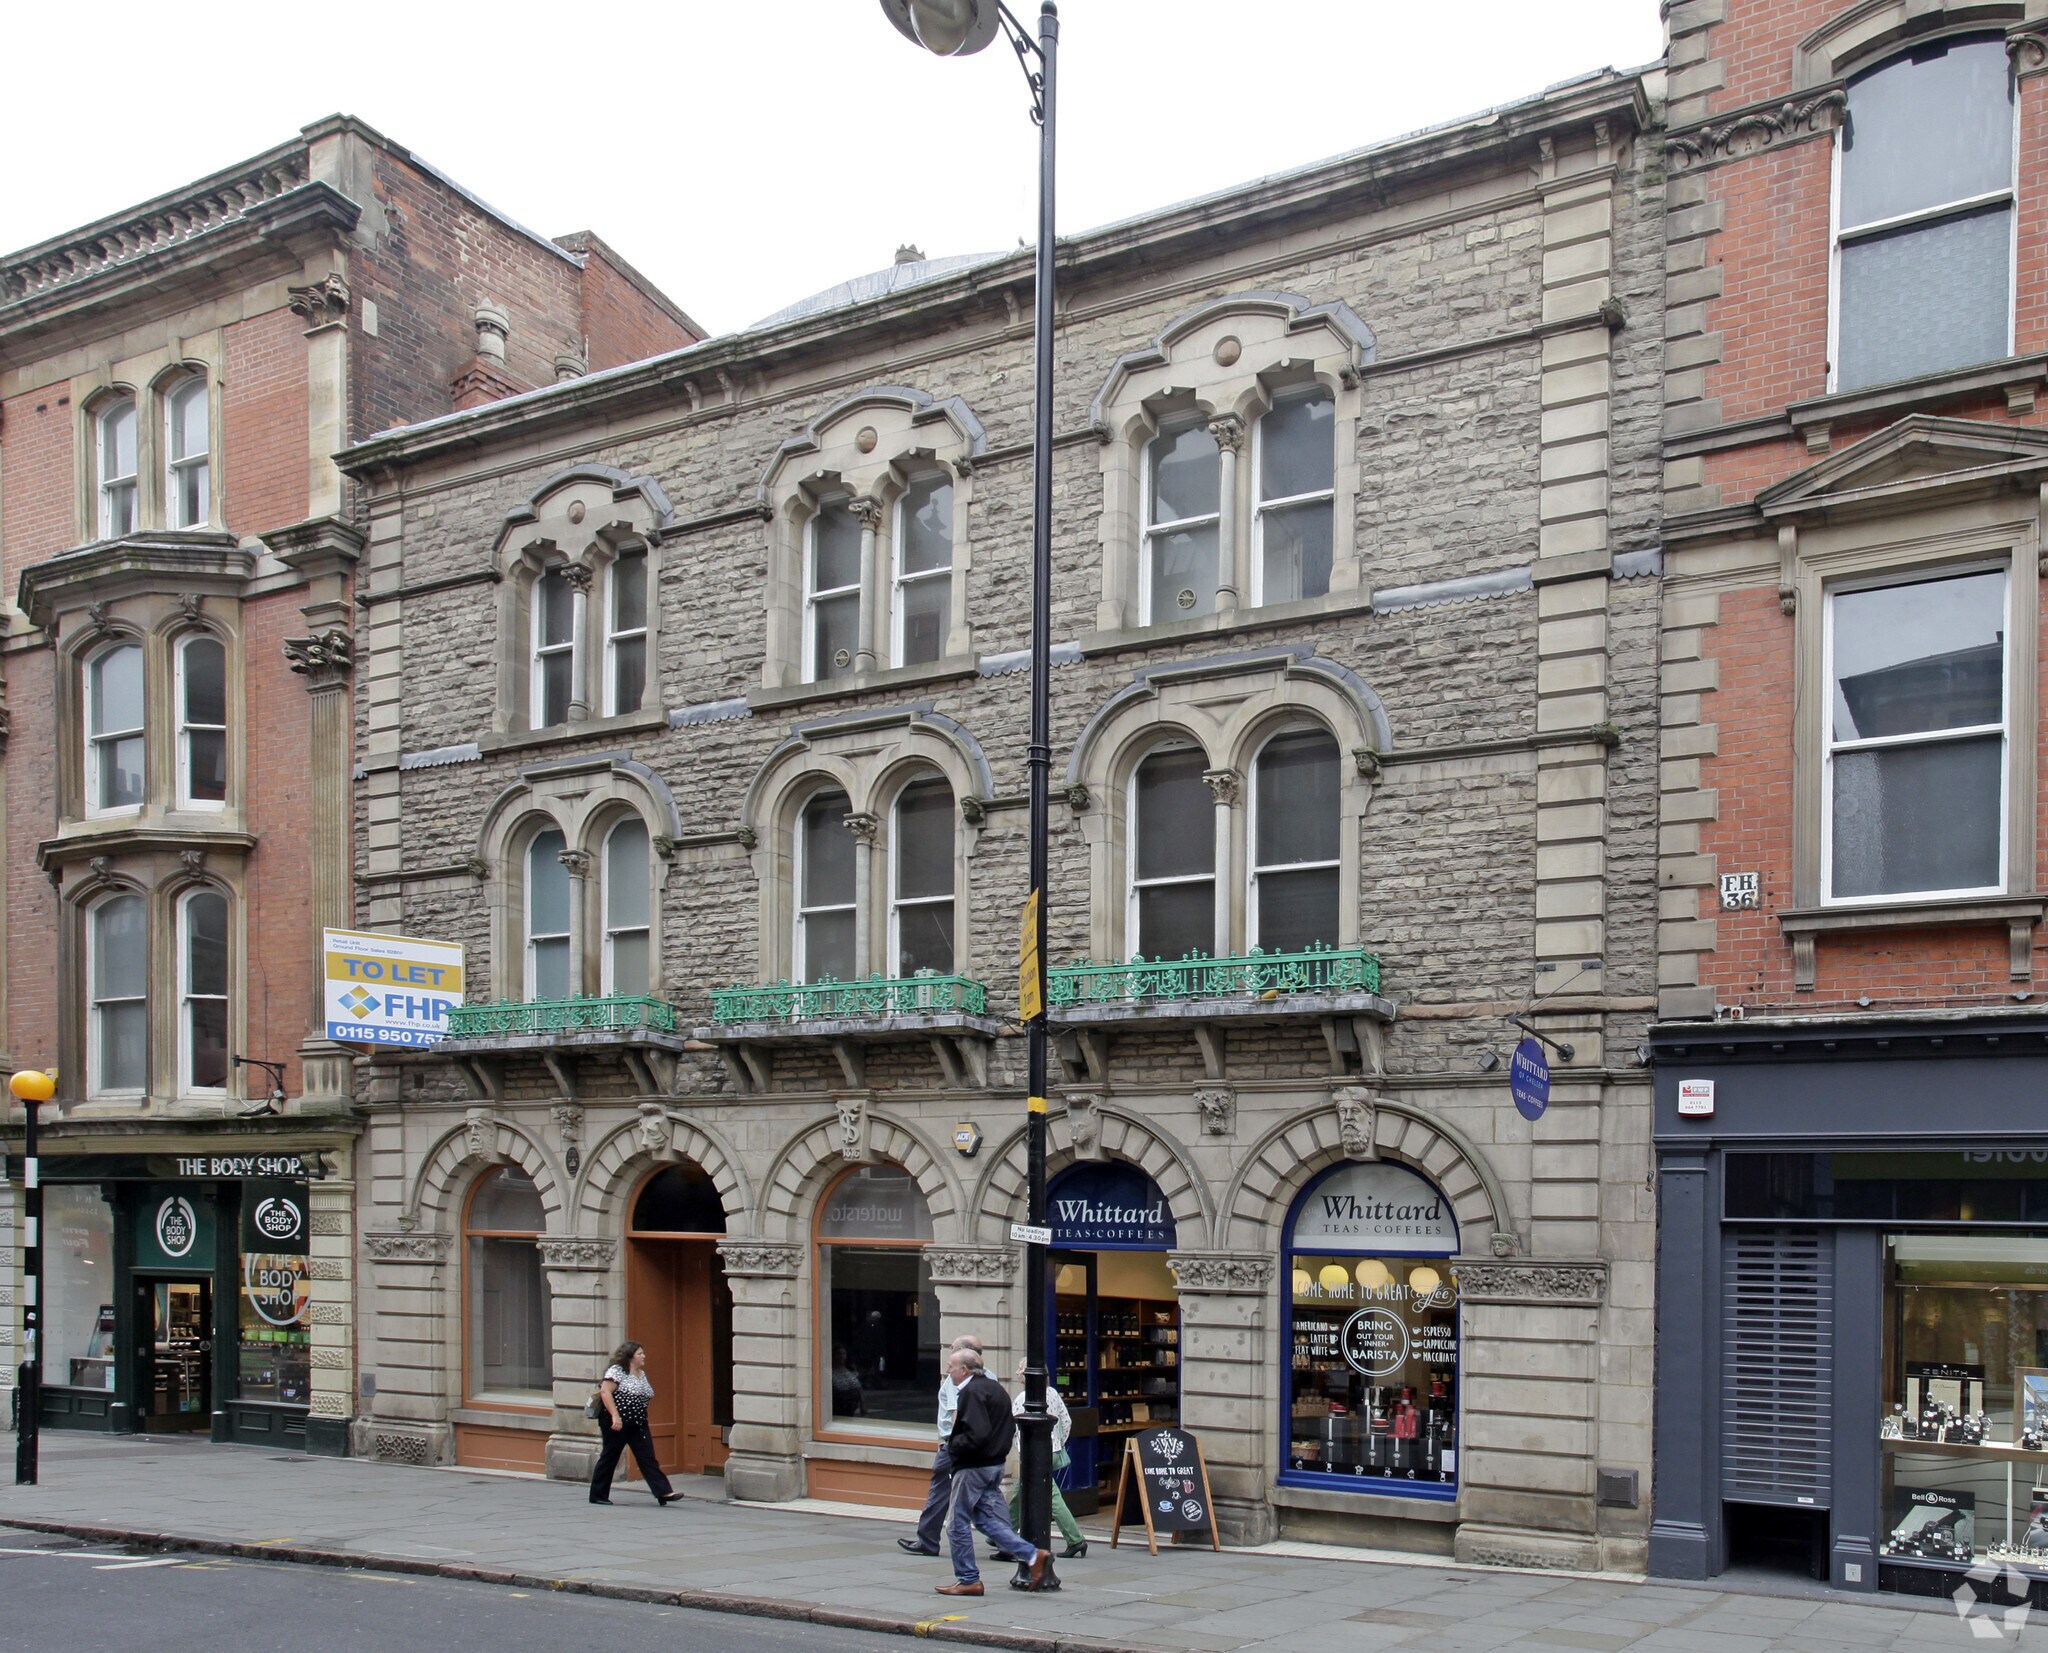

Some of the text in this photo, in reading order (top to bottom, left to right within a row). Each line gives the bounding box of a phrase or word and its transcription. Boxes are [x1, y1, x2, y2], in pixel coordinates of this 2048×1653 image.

[1726, 892, 1754, 908] 36
[343, 958, 446, 985] TO LET
[385, 993, 453, 1022] FHP
[336, 1025, 451, 1045] 0115 950 757
[1516, 1051, 1548, 1081] WHITTARD
[176, 1158, 207, 1176] THE
[211, 1157, 255, 1176] BODY
[1056, 1199, 1164, 1224] Whittard
[1321, 1195, 1442, 1220] Whittard
[169, 1216, 183, 1225] THE
[265, 1216, 293, 1224] BODY
[166, 1226, 186, 1235] BODY
[266, 1224, 292, 1232] SHOP
[167, 1235, 186, 1245] SHOP
[268, 1254, 291, 1268] THE
[260, 1270, 302, 1287] BODY
[261, 1290, 299, 1306] SHOP
[1298, 1280, 1458, 1313] COME HOME TO GREAT coffee
[1296, 1321, 1328, 1331] AMERICANO
[1357, 1320, 1393, 1330] BRING
[1423, 1326, 1452, 1337] ESPRESSO
[1310, 1333, 1328, 1344] LATTE
[1295, 1346, 1328, 1356] FLAT WHITE
[1352, 1349, 1399, 1360] BARISTA
[1922, 1368, 1968, 1376] ZENITH
[1176, 1466, 1194, 1475] GREAT
[1938, 1496, 1956, 1504] Ross
